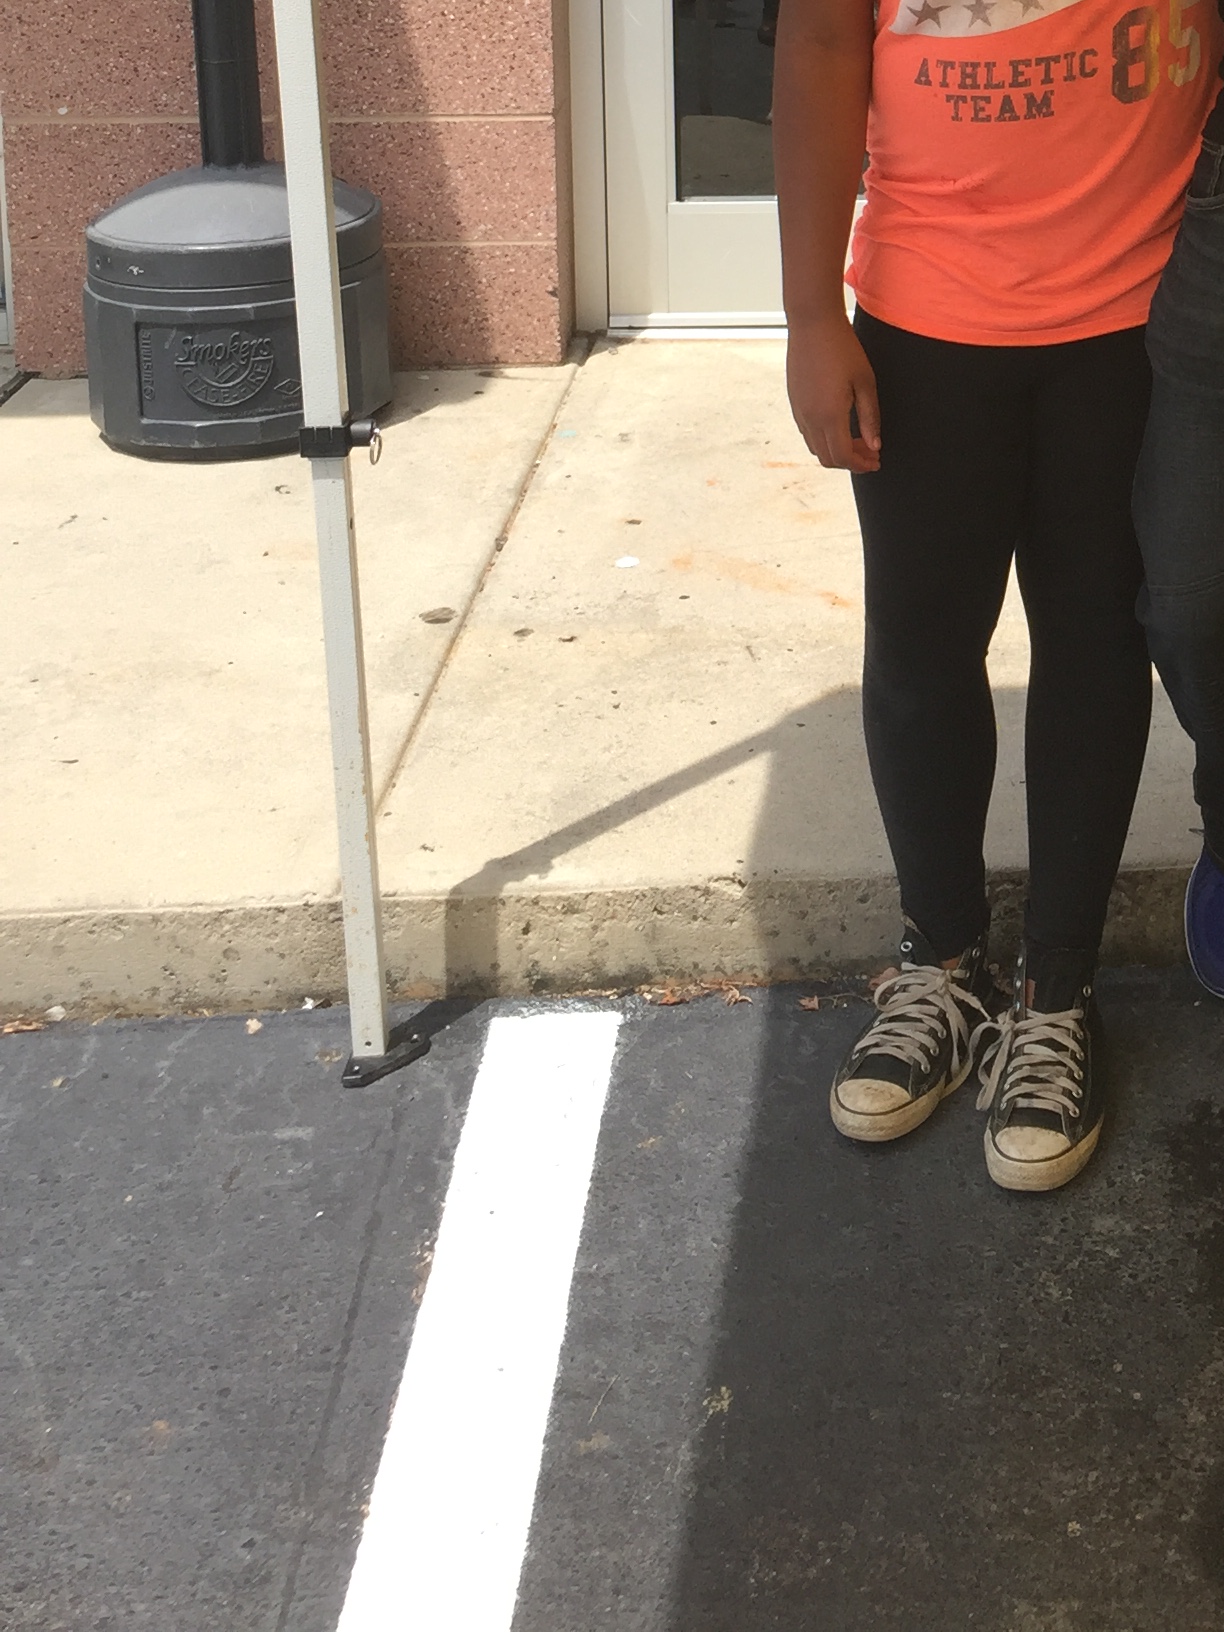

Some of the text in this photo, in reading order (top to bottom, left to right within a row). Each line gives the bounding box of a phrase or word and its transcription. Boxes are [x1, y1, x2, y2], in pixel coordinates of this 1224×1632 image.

[914, 47, 1100, 91] ATHLETIC
[945, 89, 1056, 123] TEAM
[175, 330, 273, 365] Smokers
